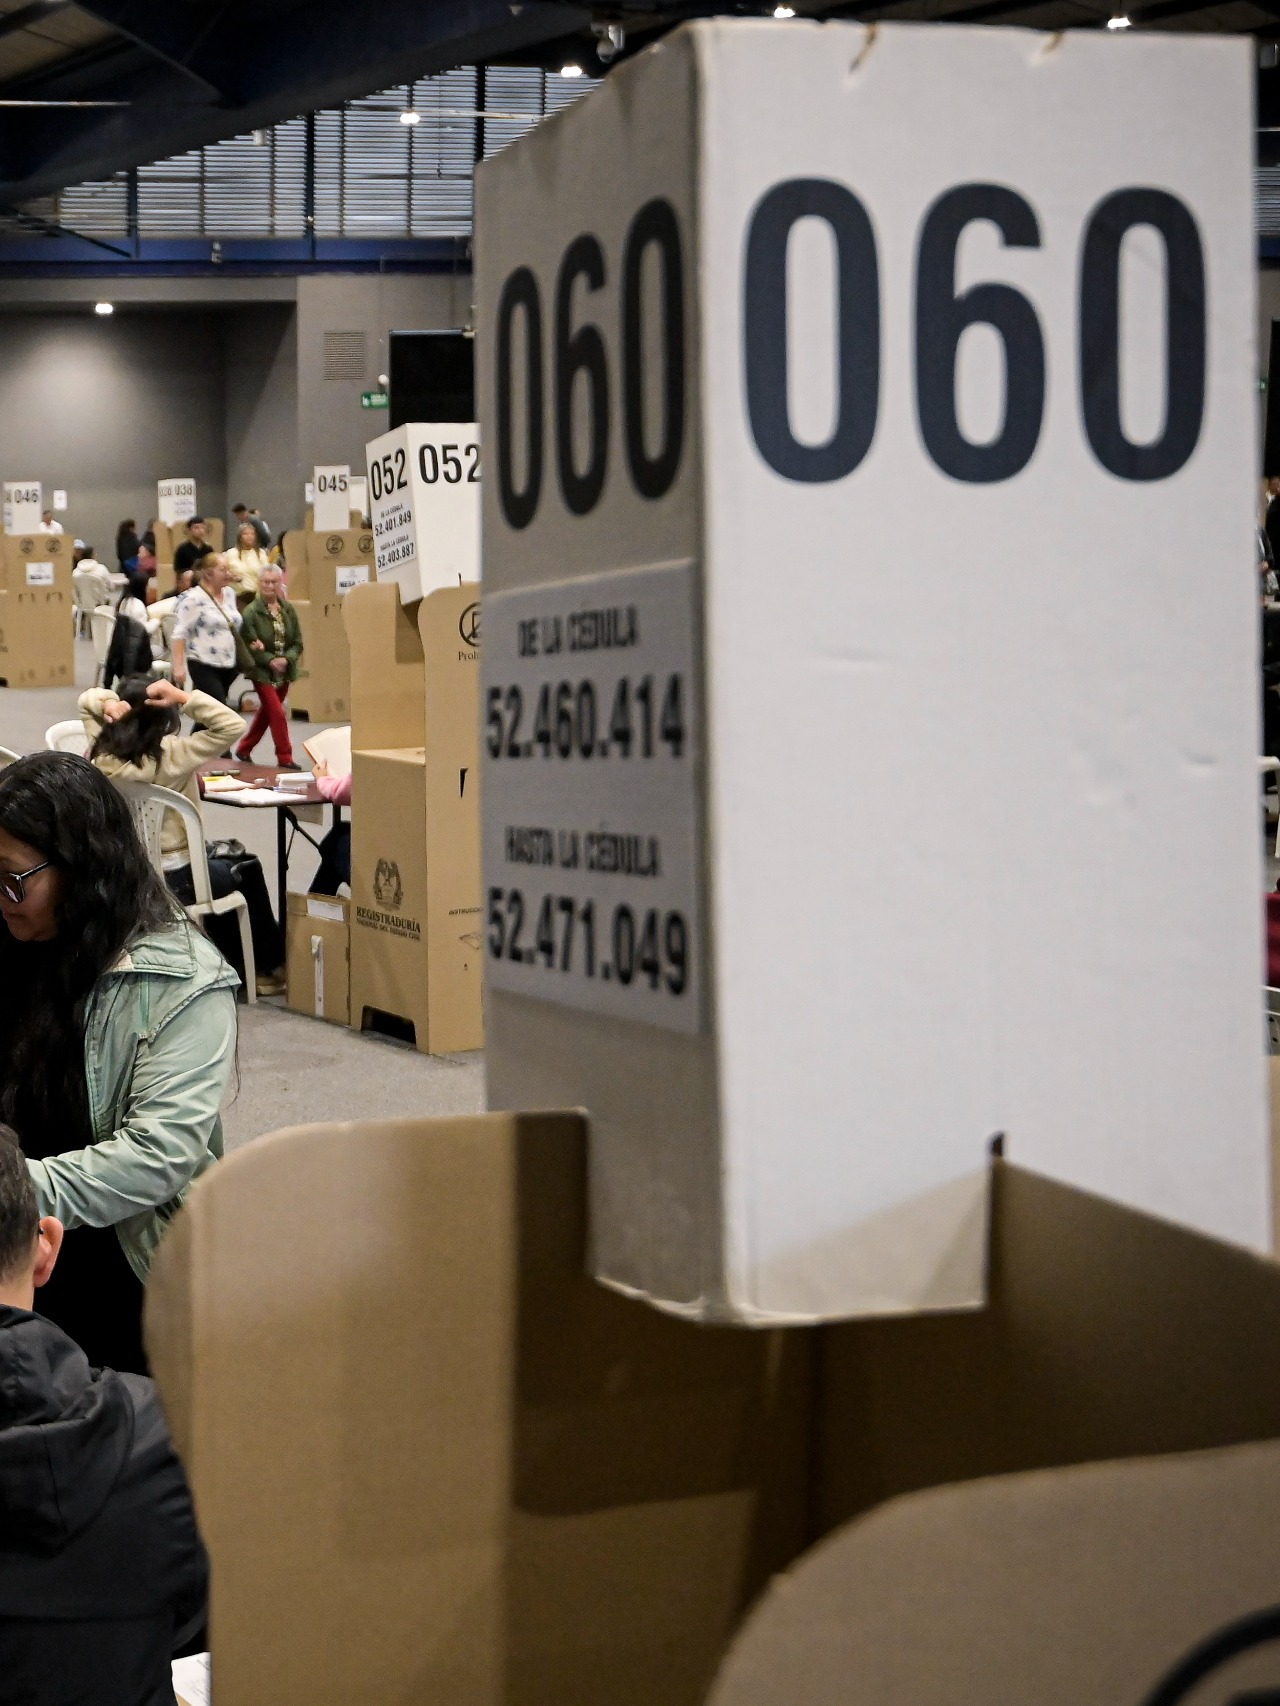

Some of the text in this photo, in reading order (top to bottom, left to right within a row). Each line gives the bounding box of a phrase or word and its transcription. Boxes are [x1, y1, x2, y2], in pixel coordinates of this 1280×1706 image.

[743, 176, 1207, 486] 060
[495, 197, 685, 531] 060
[318, 474, 348, 492] 045
[371, 448, 408, 501] 052
[418, 443, 481, 484] 052
[15, 489, 38, 503] 046
[375, 510, 412, 536] 52.401.849
[377, 542, 414, 568] 52.403.887
[518, 619, 538, 658] DE
[544, 614, 563, 655] LA
[486, 671, 685, 760] 52.460.414
[507, 826, 555, 867] HASTA
[560, 829, 579, 870] LA
[356, 906, 421, 933] REGISTRADURÍA
[487, 888, 688, 996] 52.471.049
